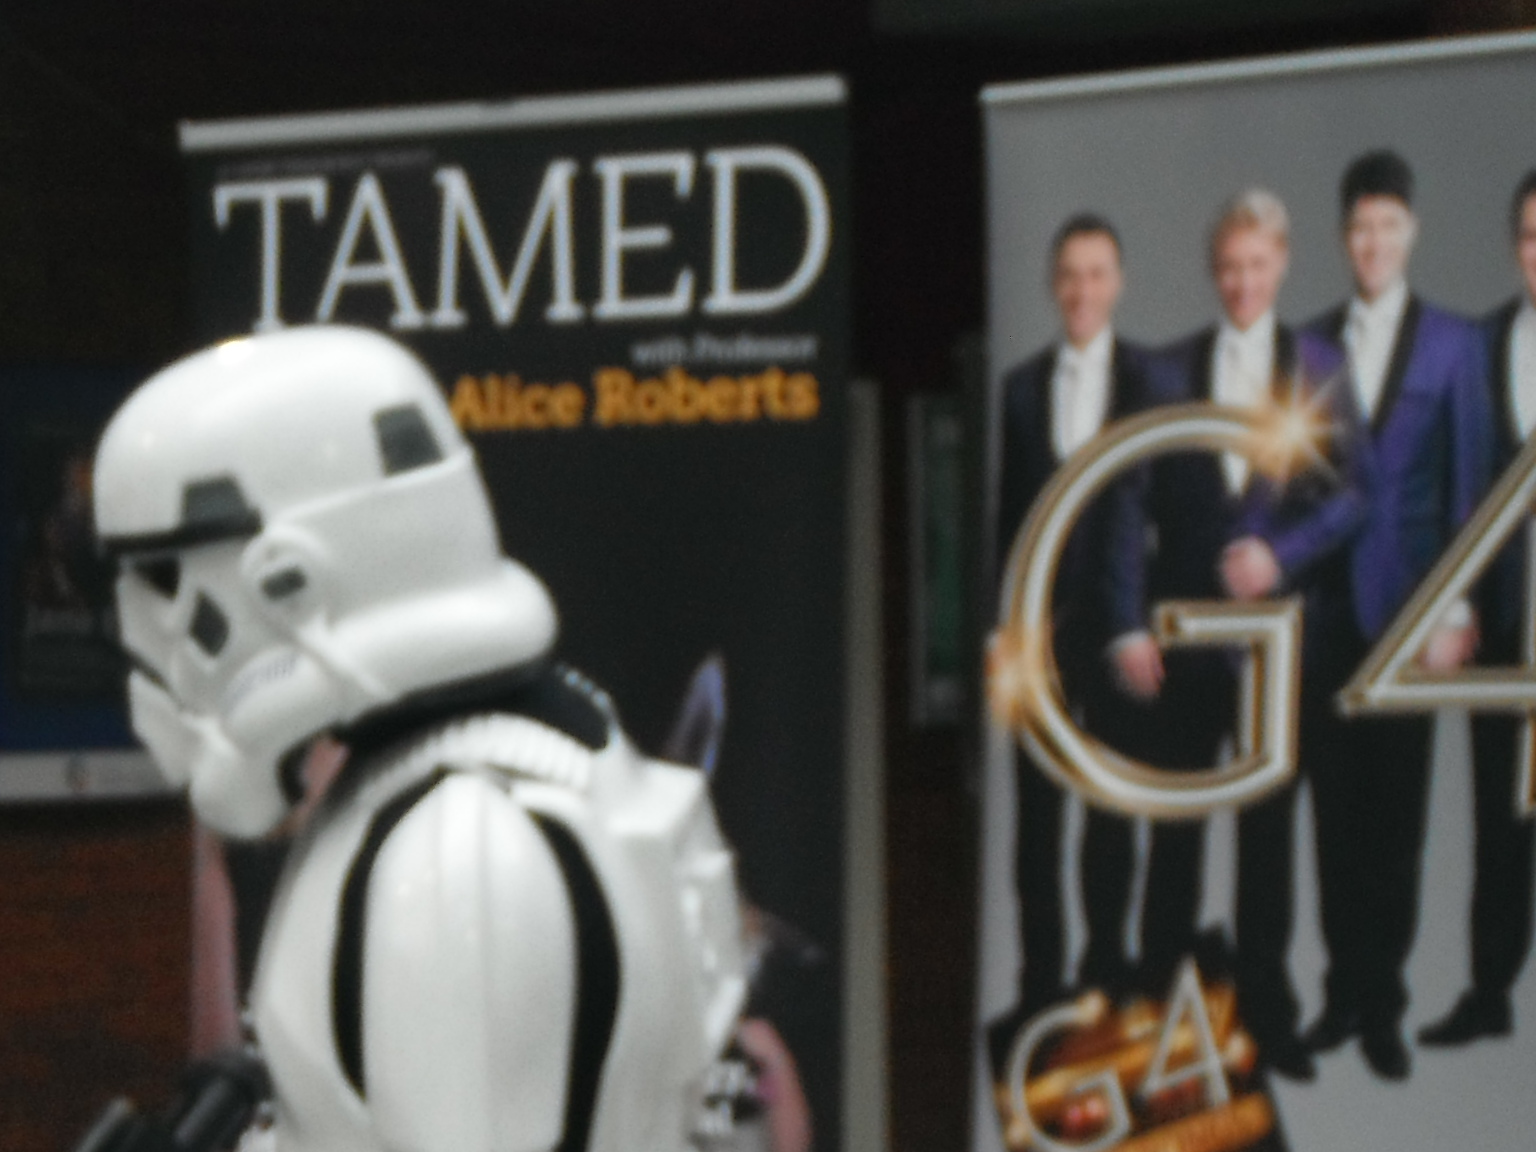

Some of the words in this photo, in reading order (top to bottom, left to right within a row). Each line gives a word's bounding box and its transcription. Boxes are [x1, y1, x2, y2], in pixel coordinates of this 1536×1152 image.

[213, 144, 832, 332] TAMED
[447, 372, 586, 432] Alice
[593, 365, 820, 428] Roberts
